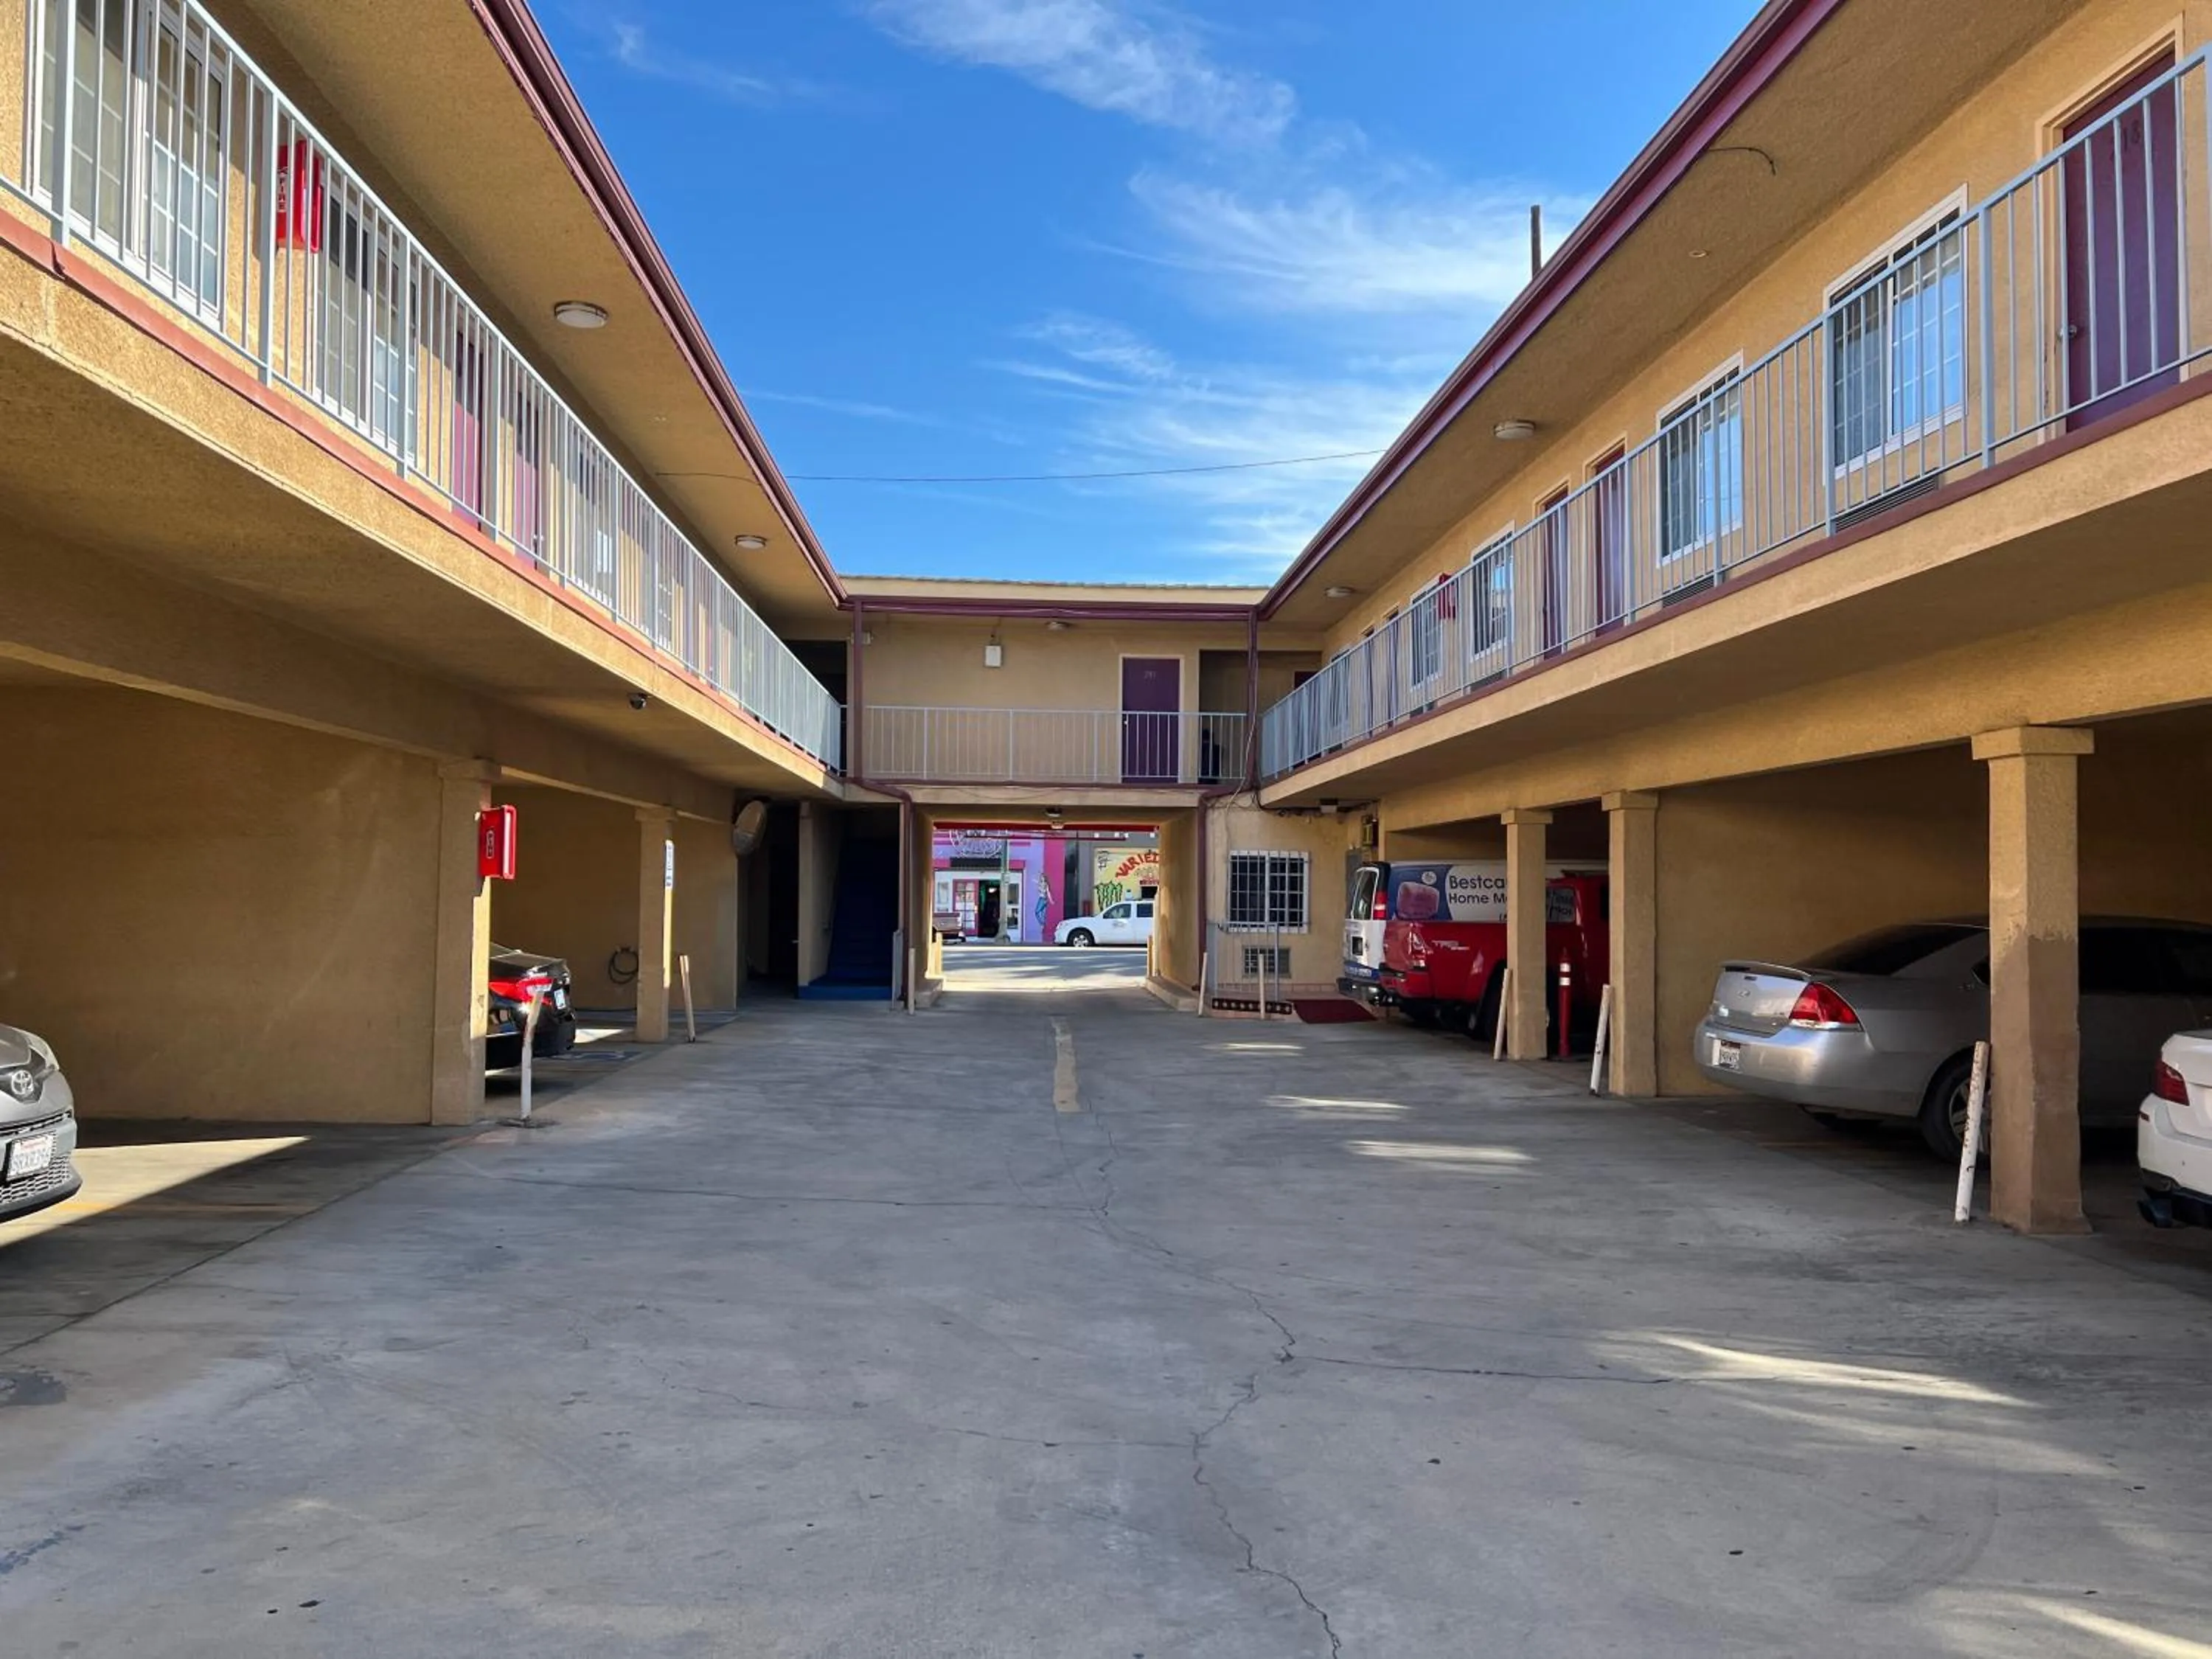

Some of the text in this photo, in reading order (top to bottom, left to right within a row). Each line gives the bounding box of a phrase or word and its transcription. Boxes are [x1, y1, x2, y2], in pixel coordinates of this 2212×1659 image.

[1449, 875, 1507, 889] Bestca
[1449, 893, 1507, 904] Home M
